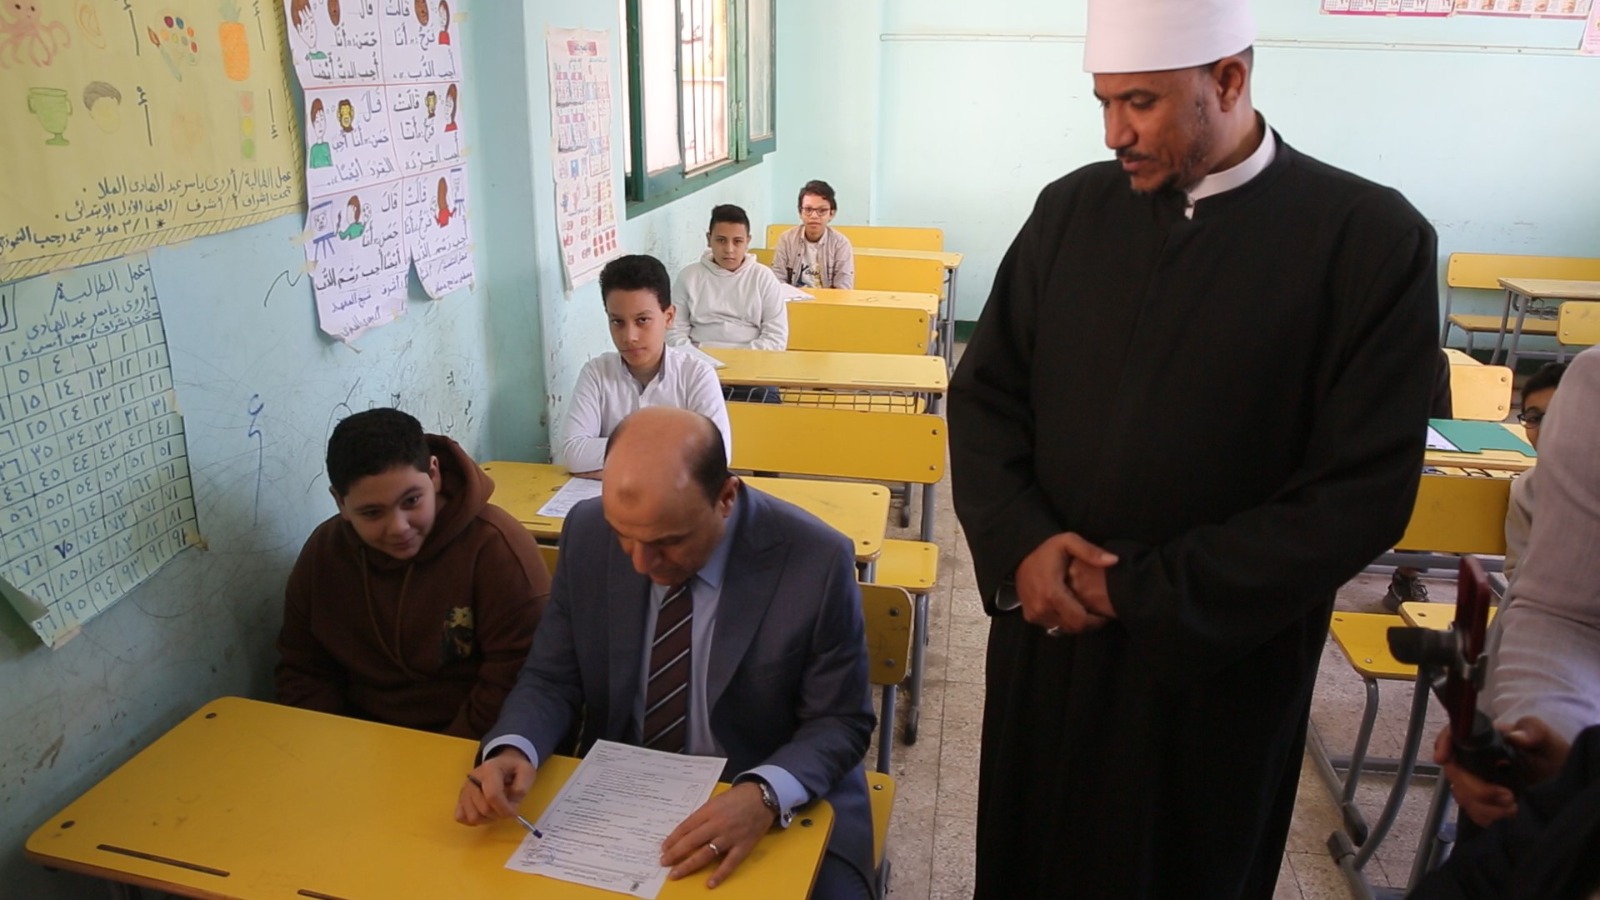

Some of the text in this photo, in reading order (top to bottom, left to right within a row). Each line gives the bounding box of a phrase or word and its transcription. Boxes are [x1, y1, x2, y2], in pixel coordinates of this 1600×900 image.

[120, 358, 132, 377] ١٢
[147, 350, 159, 368] ١١
[88, 366, 107, 390] ١٣
[149, 373, 162, 391] ٢١
[55, 379, 74, 400] ١٤
[120, 382, 135, 403] ٢٢
[20, 394, 40, 414] ١٥
[93, 392, 111, 415] ٢٣
[151, 395, 167, 415] ٣١
[59, 404, 82, 428] ٢٤
[124, 406, 139, 426] ٣٢
[26, 420, 47, 439] ٢٥
[156, 419, 170, 435] ٤١
[66, 429, 87, 451] ٣٤
[128, 429, 143, 447] ٤٢
[30, 444, 53, 466] ٣٥
[72, 453, 90, 473] ٤٤
[10, 440, 171, 523] ٥١ ٥٢ ٥٣ ٥٤ ٥٥ ٥٦
[39, 468, 60, 487] ٤٥
[161, 463, 175, 480] ٦١
[3, 481, 27, 502] ٤٦
[132, 473, 151, 493] ٦٢
[164, 484, 178, 500] ٧١
[76, 500, 97, 522] ٦٤
[169, 506, 182, 526] ٨١
[46, 518, 70, 534] ٦٥
[79, 526, 99, 545] ٧٤
[11, 527, 39, 549] ٦٦
[172, 527, 186, 548] ٩١
[148, 540, 165, 563] ٩٢
[15, 554, 42, 576] ٧٦
[89, 550, 106, 575] ٨٤
[60, 569, 79, 593] ٨٥
[94, 575, 117, 601] ٩٤
[64, 599, 87, 620] ٩٥
[36, 614, 57, 639] ٩٦
